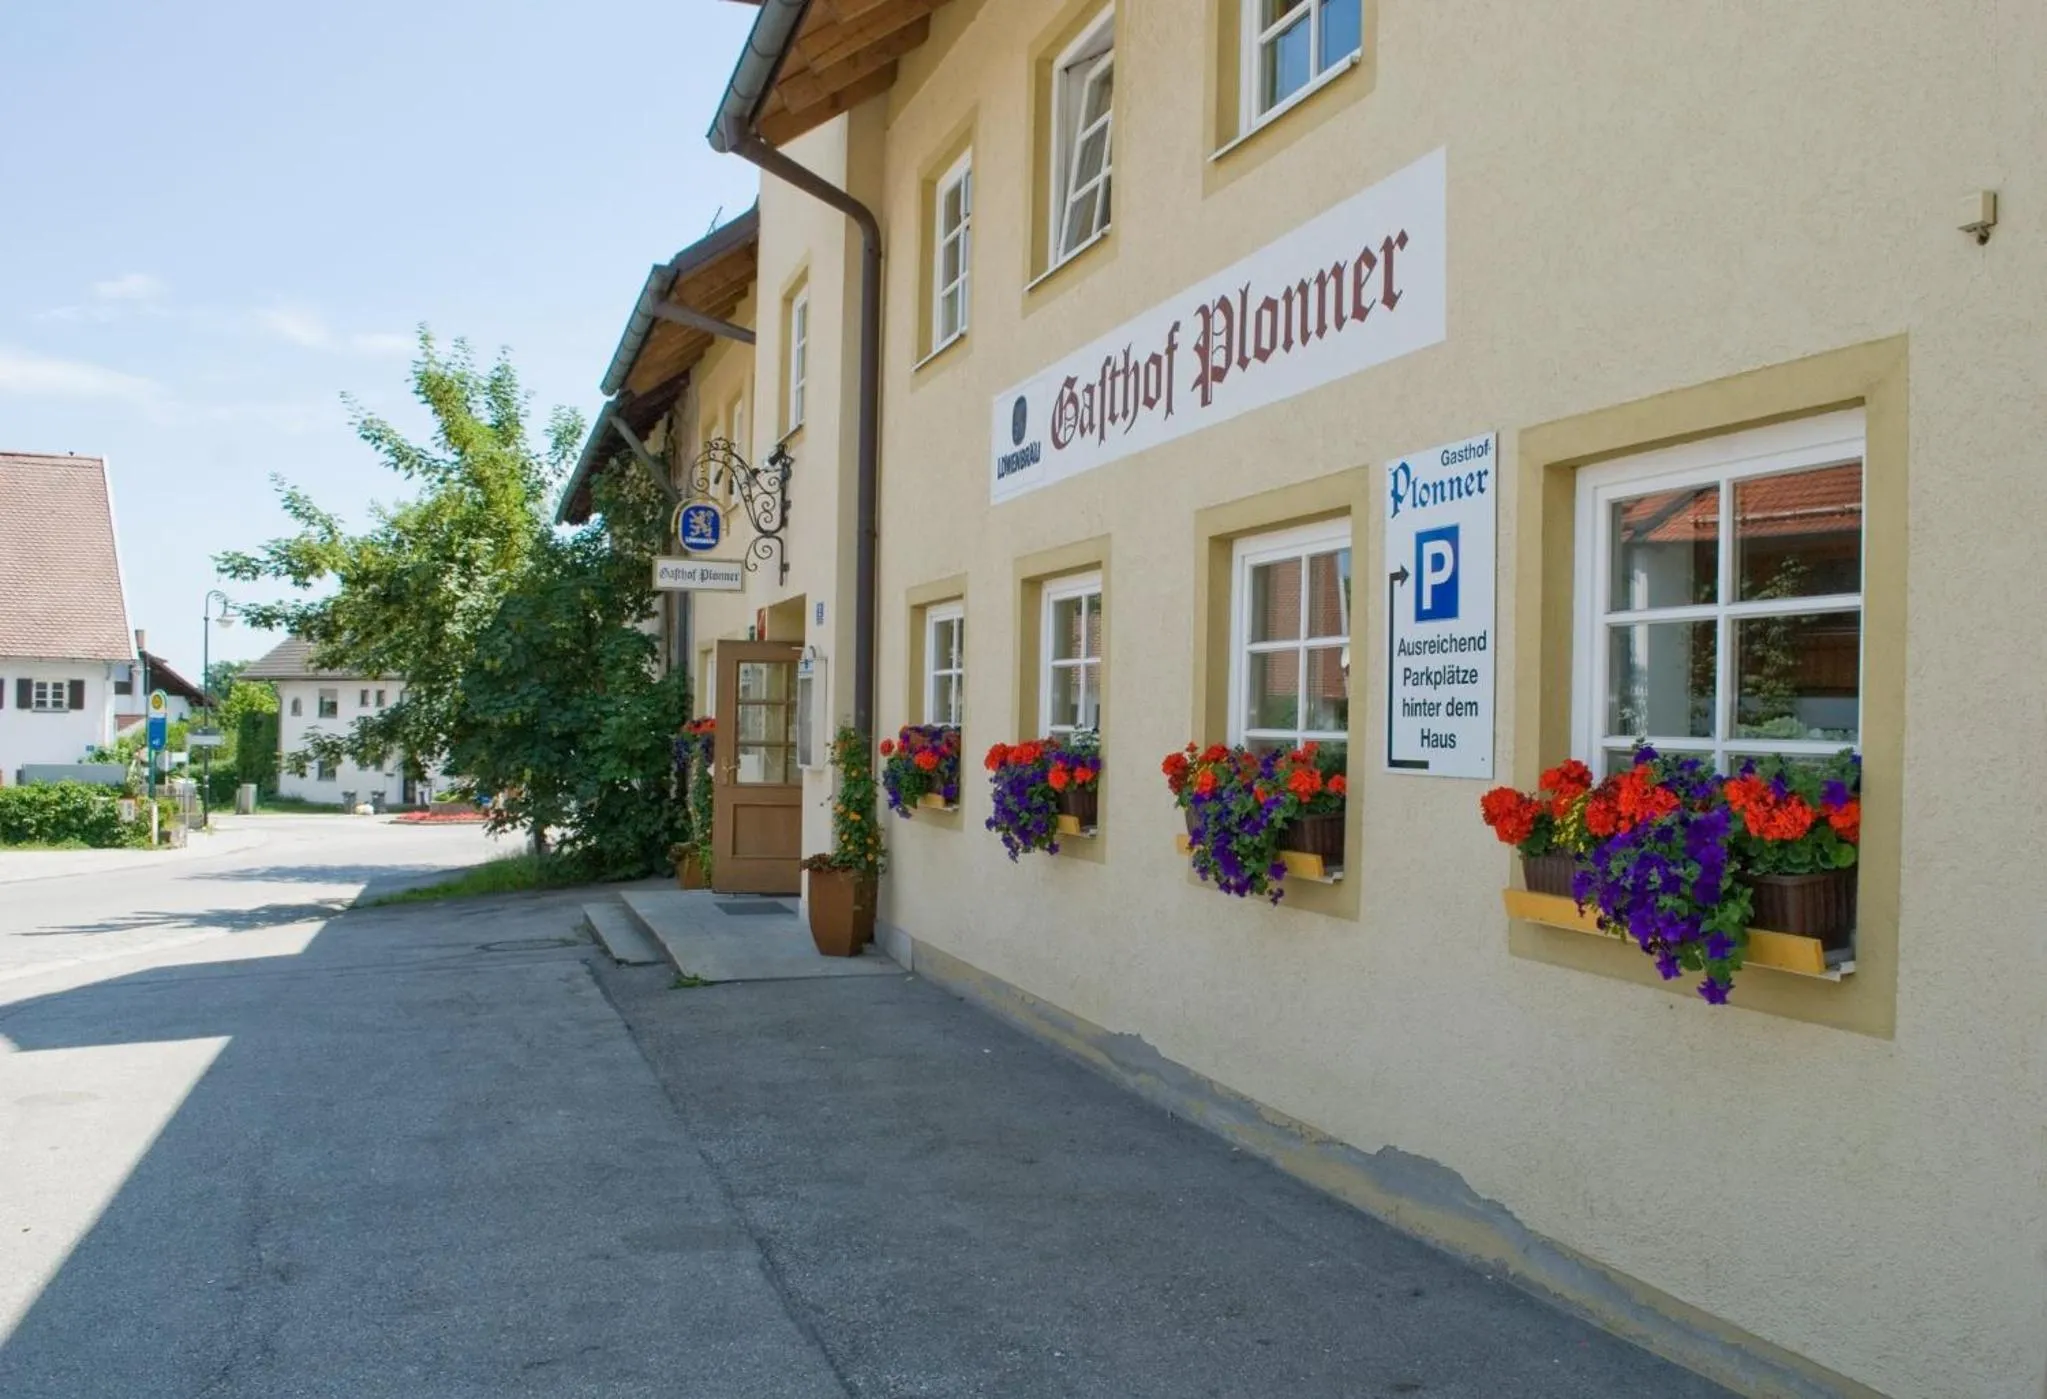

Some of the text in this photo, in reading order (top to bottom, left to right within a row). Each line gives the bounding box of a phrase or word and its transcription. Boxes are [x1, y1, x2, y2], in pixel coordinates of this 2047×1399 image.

[1191, 228, 1409, 408] Plonner
[1440, 438, 1490, 467] Gasthof
[1388, 461, 1489, 519] Plonner
[1422, 539, 1454, 610] P
[1397, 629, 1487, 657] Ausreichend
[1403, 664, 1479, 690] Parkplätze
[1402, 696, 1479, 718] hinter dem
[1420, 727, 1457, 749] Haus
